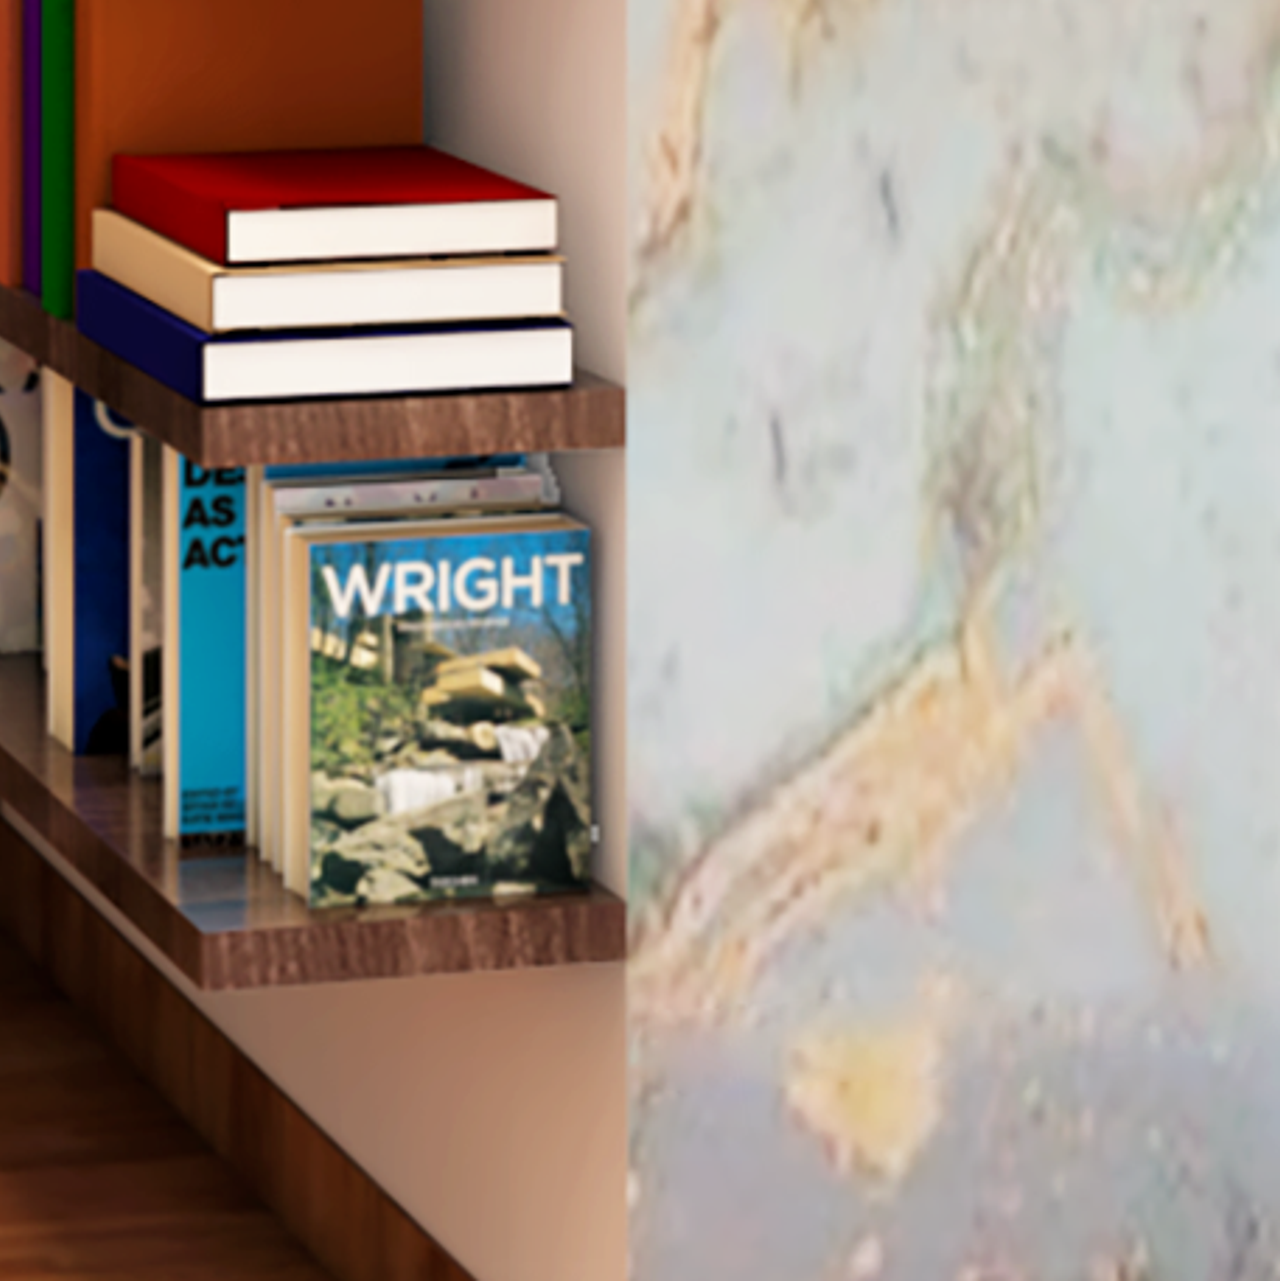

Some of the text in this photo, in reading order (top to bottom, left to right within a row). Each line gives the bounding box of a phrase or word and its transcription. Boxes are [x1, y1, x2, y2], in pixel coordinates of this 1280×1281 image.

[183, 496, 236, 530] AS
[183, 535, 244, 570] AC
[322, 552, 584, 618] WRIGHT
